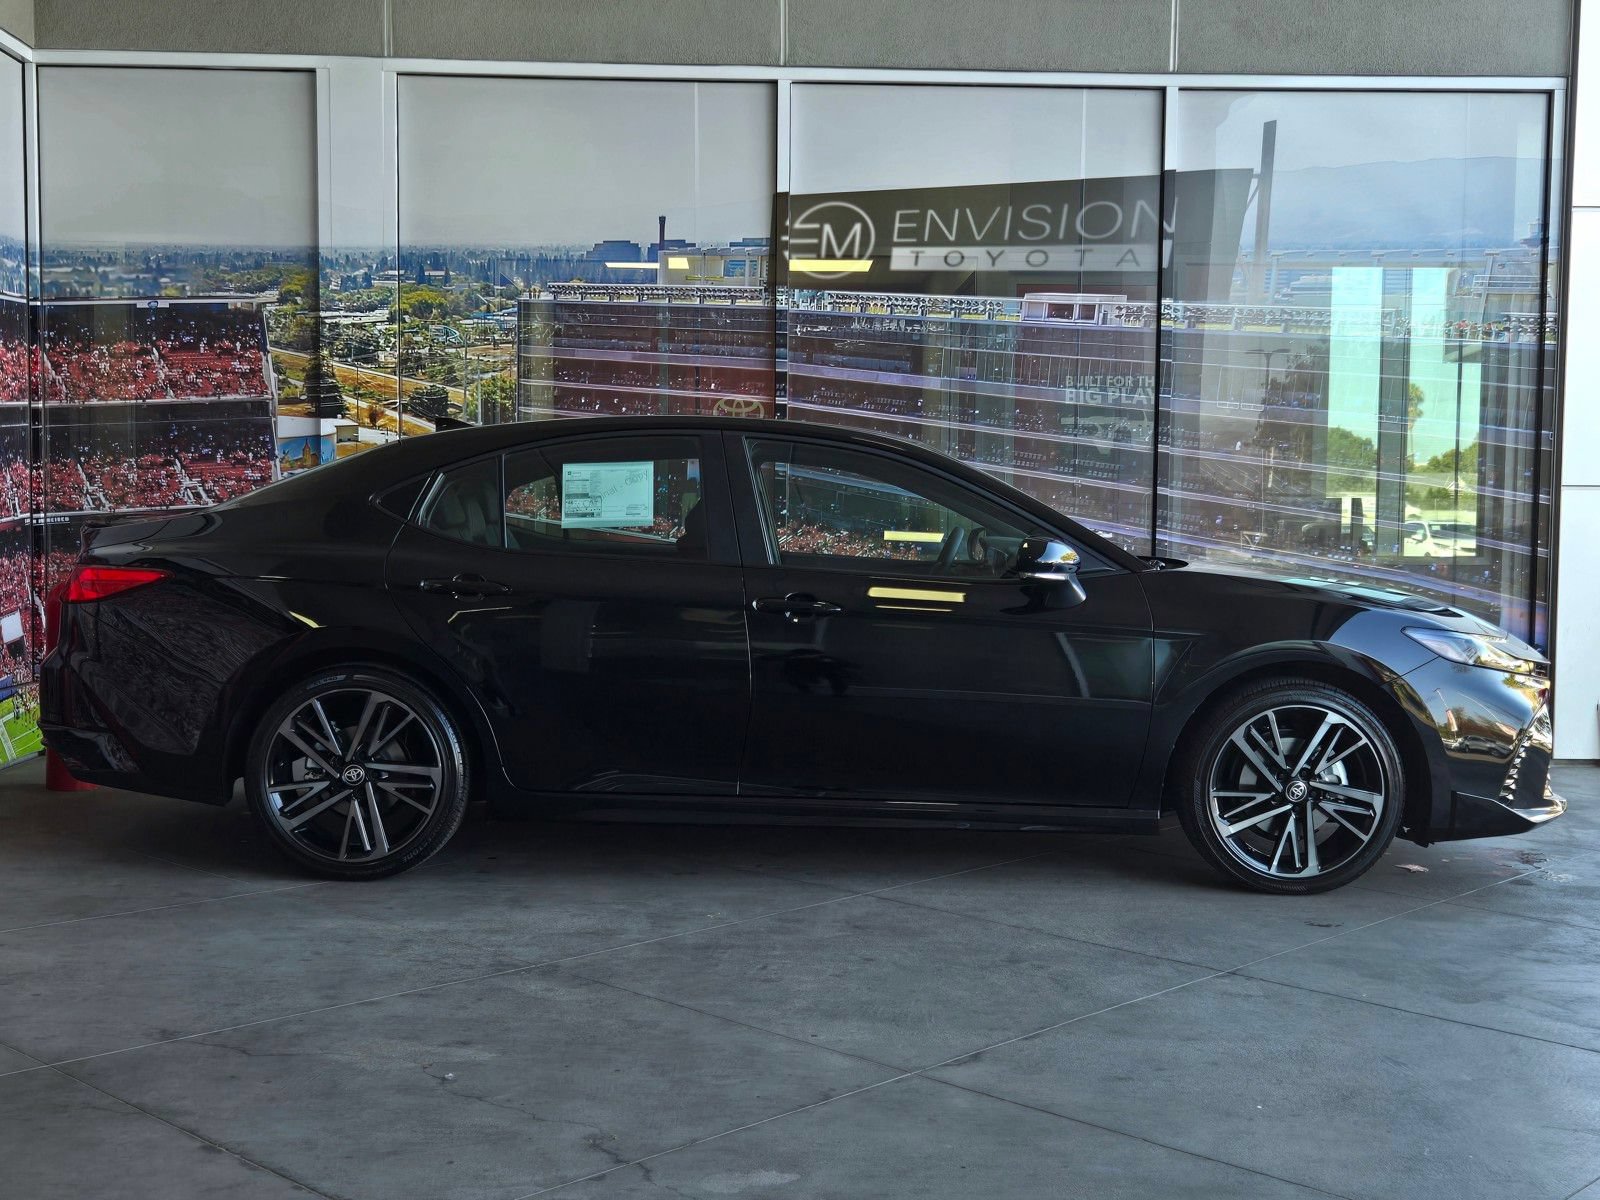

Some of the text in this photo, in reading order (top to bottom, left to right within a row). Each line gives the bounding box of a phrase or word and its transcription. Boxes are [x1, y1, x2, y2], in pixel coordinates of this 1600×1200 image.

[891, 196, 1179, 243] ENVISION
[909, 248, 1141, 268] TOYOTA
[1065, 375, 1155, 387] BUILT FOR TH
[1065, 387, 1102, 404] BIG
